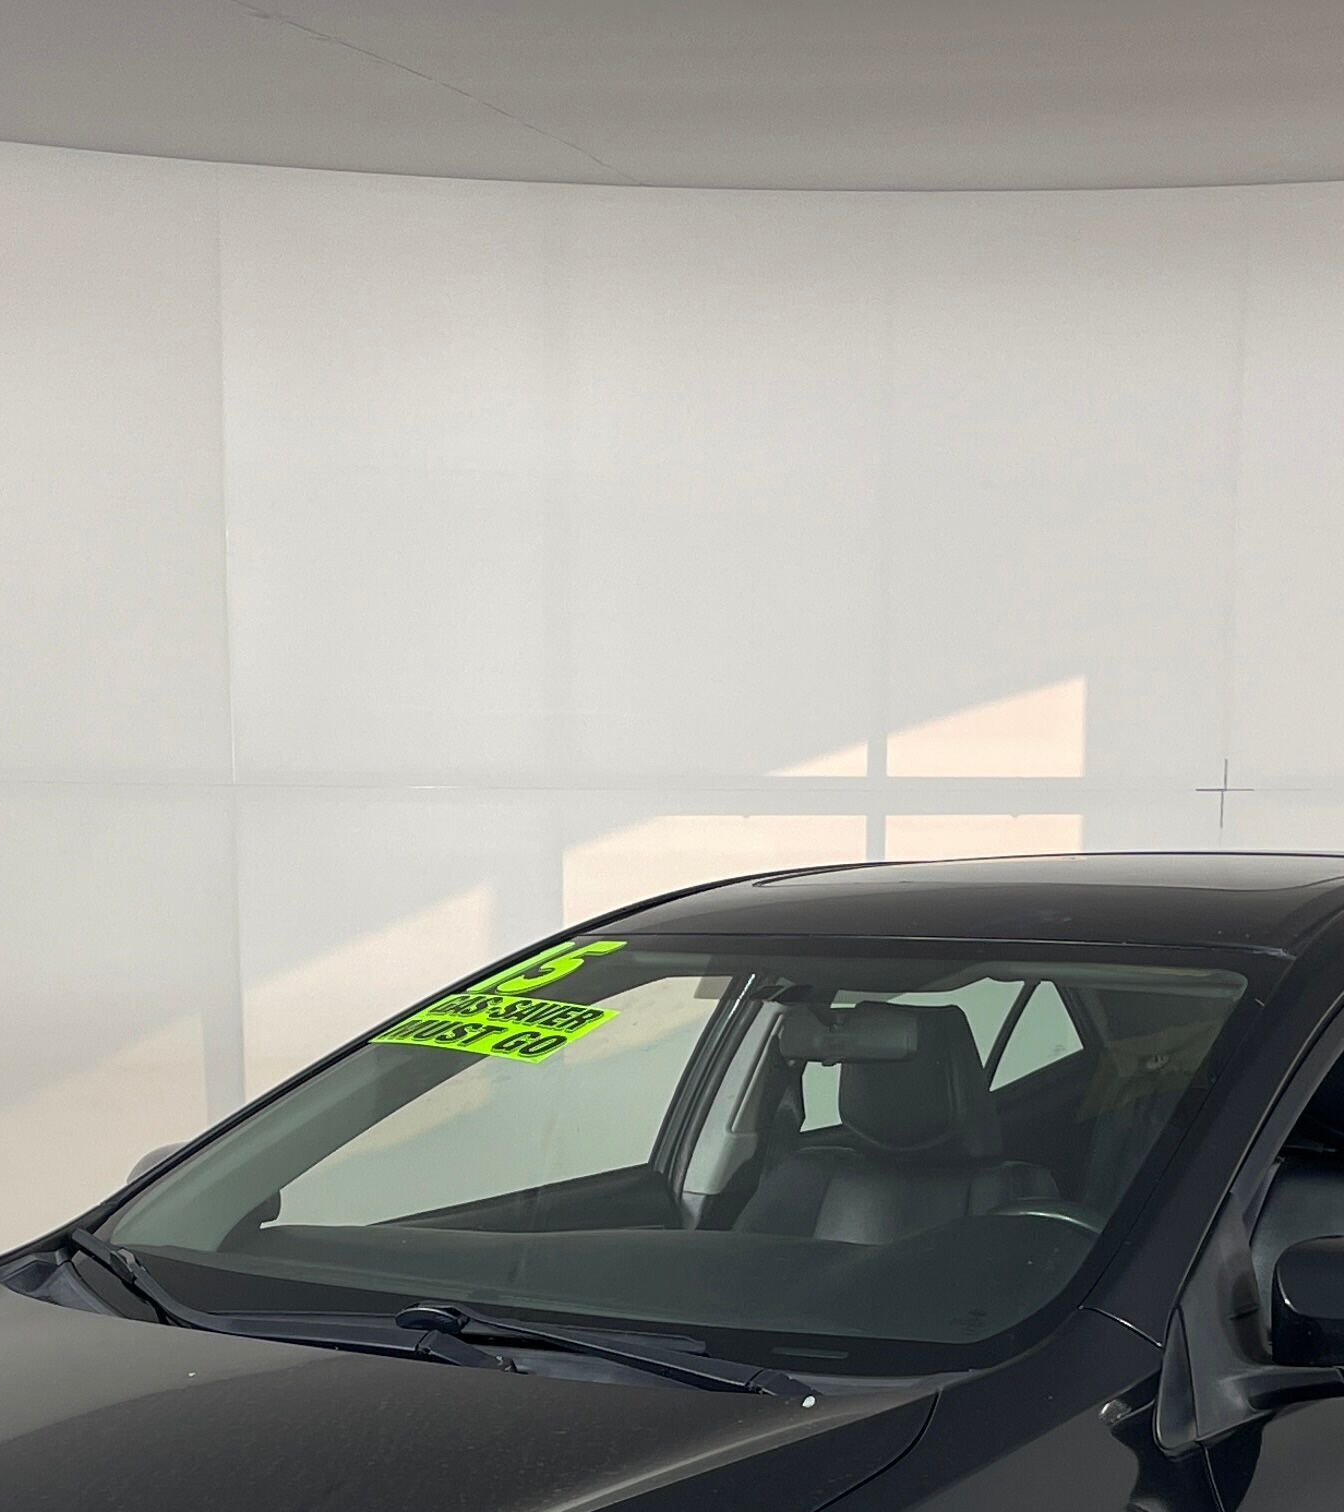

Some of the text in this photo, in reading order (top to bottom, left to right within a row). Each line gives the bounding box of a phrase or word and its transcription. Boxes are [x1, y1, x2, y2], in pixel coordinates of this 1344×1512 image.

[465, 940, 628, 995] 15
[380, 1018, 568, 1057] MUST GO
